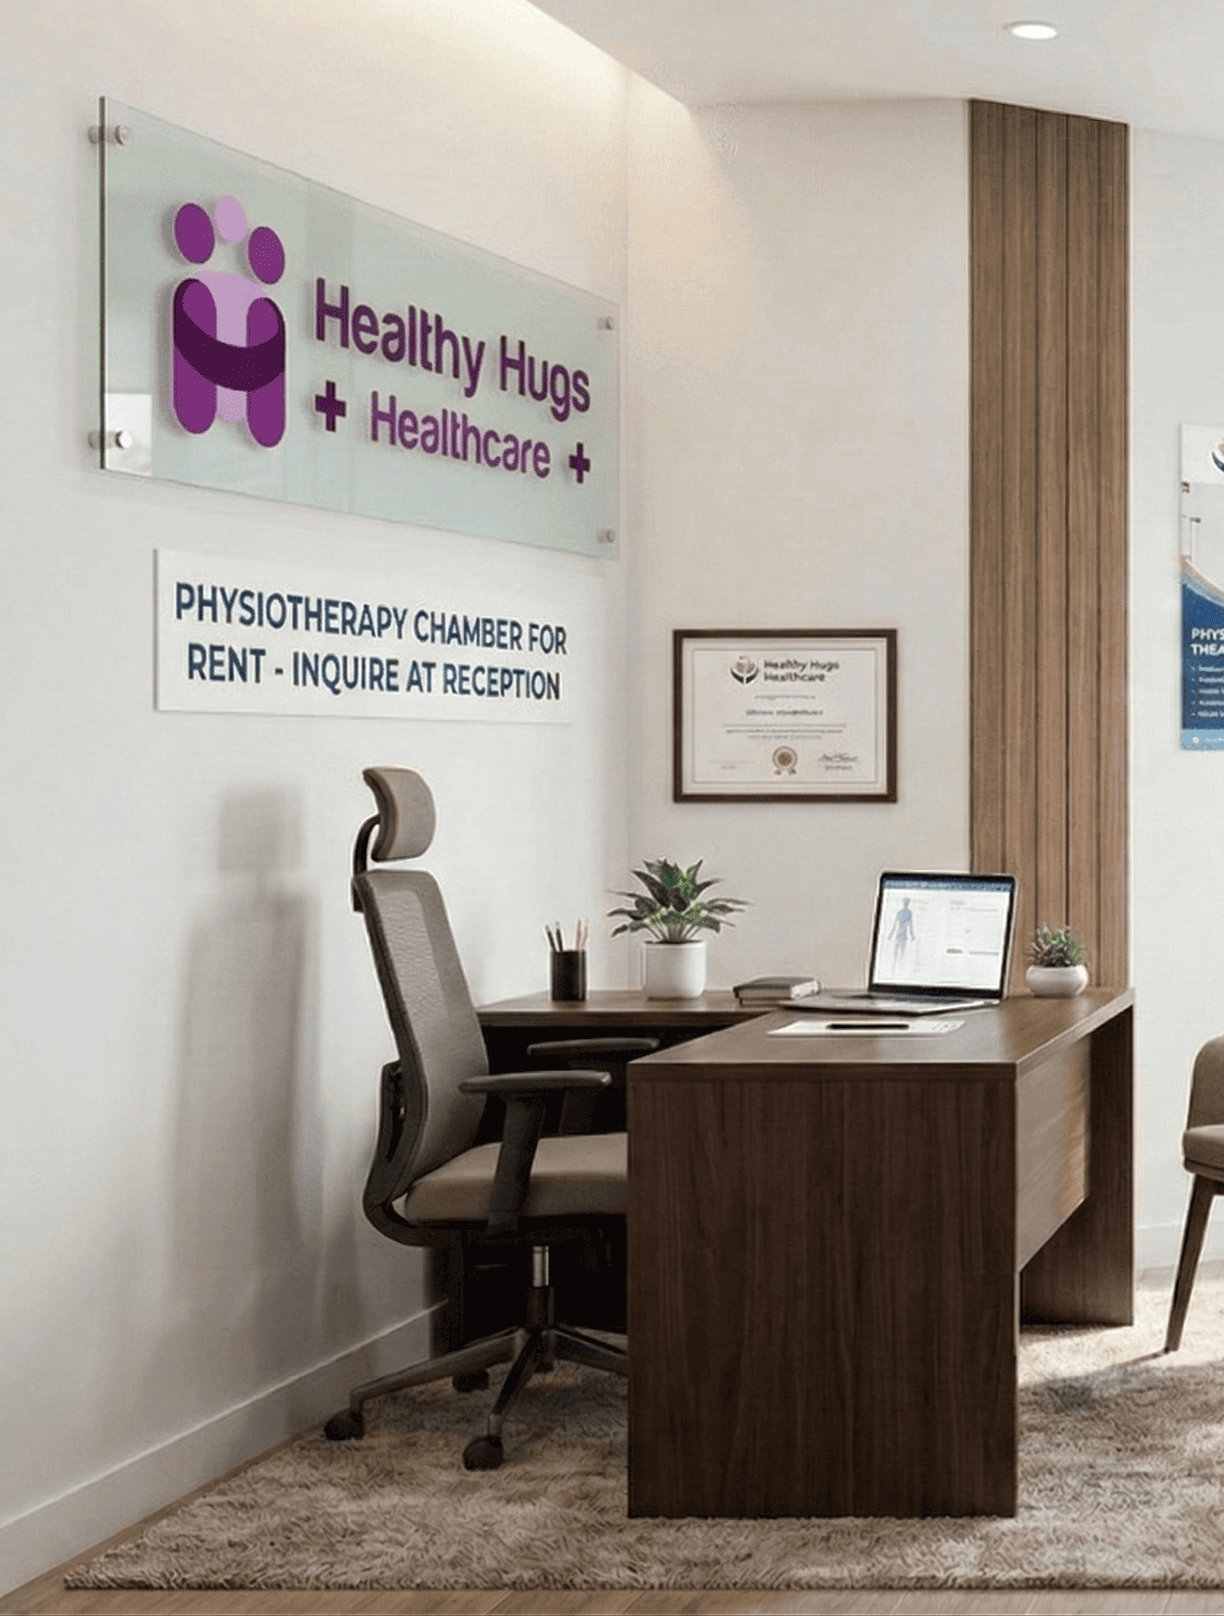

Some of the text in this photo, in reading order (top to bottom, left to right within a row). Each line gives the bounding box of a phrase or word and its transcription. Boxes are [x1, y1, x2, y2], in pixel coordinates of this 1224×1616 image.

[315, 277, 591, 423] Healthy Hugs
[370, 390, 551, 479] Healthcare
[175, 581, 568, 656] PHYSIOTHERAPY CHAMBER FOR
[187, 641, 266, 684] RENT
[292, 650, 400, 696] INQUIRE
[406, 660, 437, 694] AT
[442, 662, 561, 701] RECEPTION
